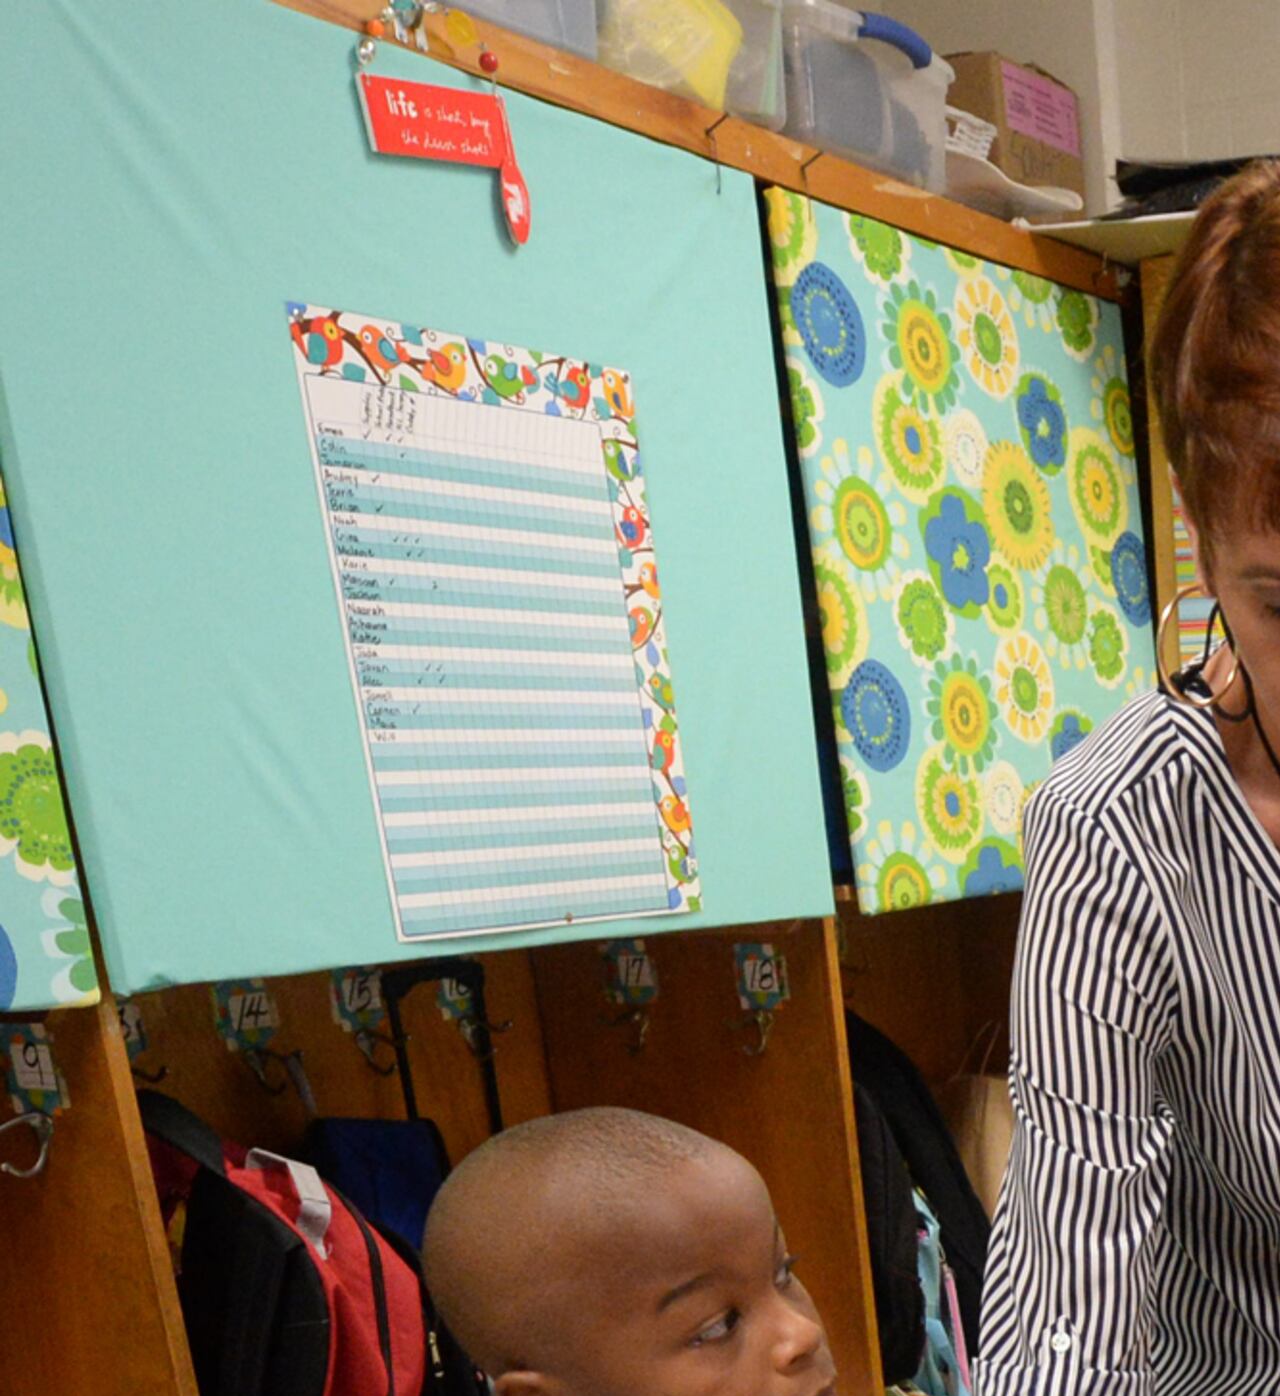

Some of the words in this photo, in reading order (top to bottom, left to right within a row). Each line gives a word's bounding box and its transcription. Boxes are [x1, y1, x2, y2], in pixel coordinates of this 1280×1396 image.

[385, 88, 419, 119] life
[625, 955, 646, 985] 17
[749, 958, 777, 991] 18
[237, 996, 268, 1031] 14
[22, 1041, 45, 1086] 9
